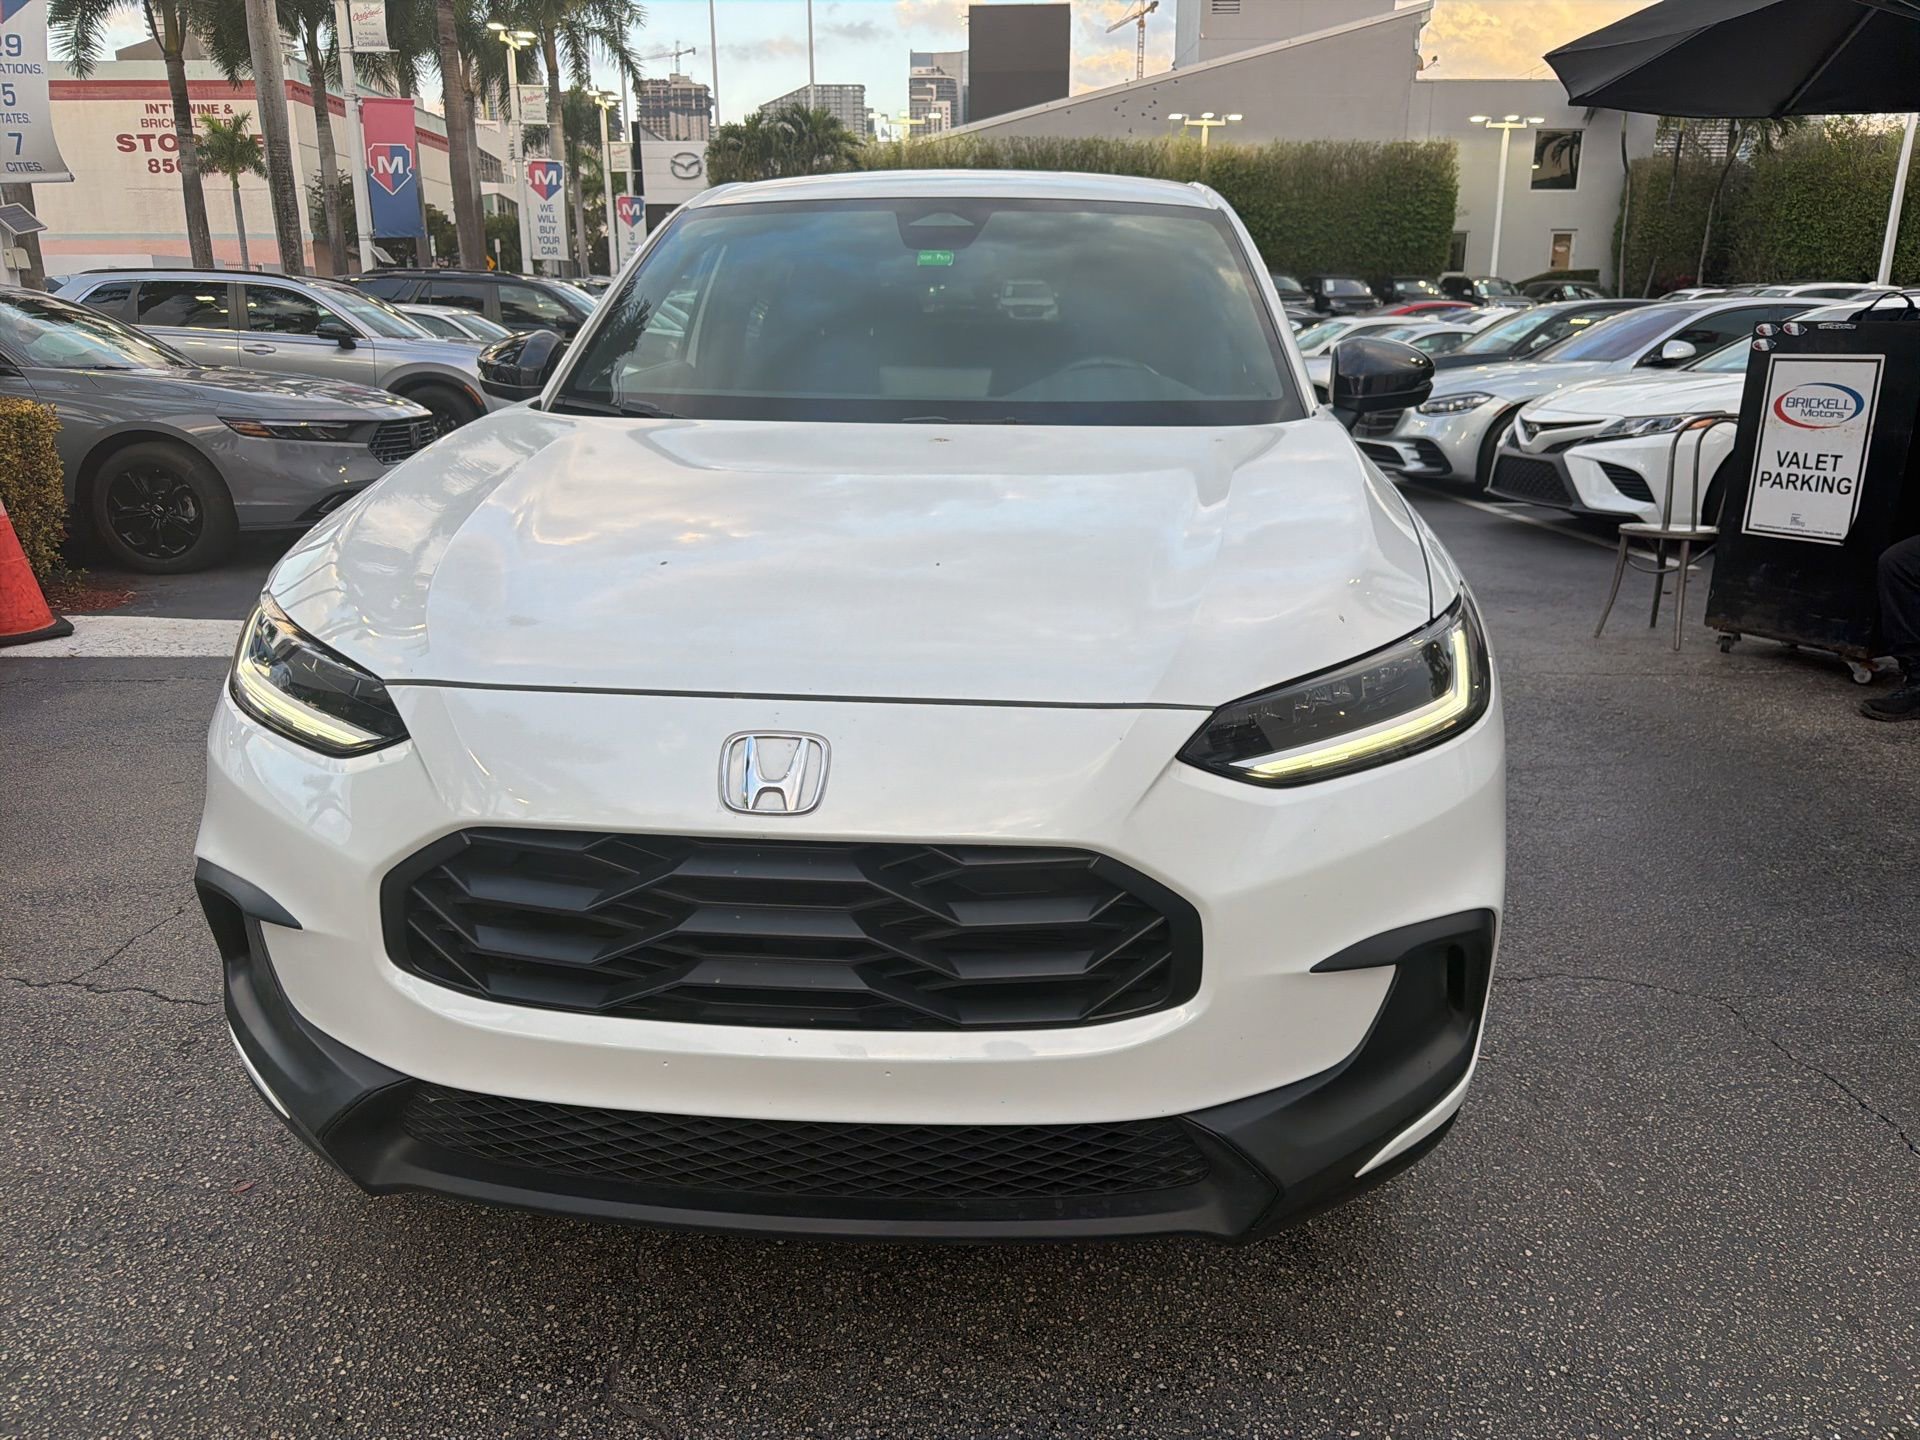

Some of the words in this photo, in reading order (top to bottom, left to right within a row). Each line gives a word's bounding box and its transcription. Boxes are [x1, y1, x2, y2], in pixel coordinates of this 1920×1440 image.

[0, 34, 22, 58] 9
[223, 103, 234, 115] &
[7, 133, 23, 156] 7
[6, 163, 45, 173] CITIES.
[377, 156, 404, 174] M
[540, 204, 554, 213] WE
[537, 214, 558, 224] WILL
[540, 225, 557, 235] BUY
[537, 236, 561, 245] YOUR
[628, 231, 636, 241] 3
[541, 246, 559, 256] CAR
[1785, 397, 1853, 411] BRICKELL
[1800, 408, 1845, 419] Motors
[1776, 450, 1843, 473] VALET
[1759, 471, 1852, 495] PARKING
